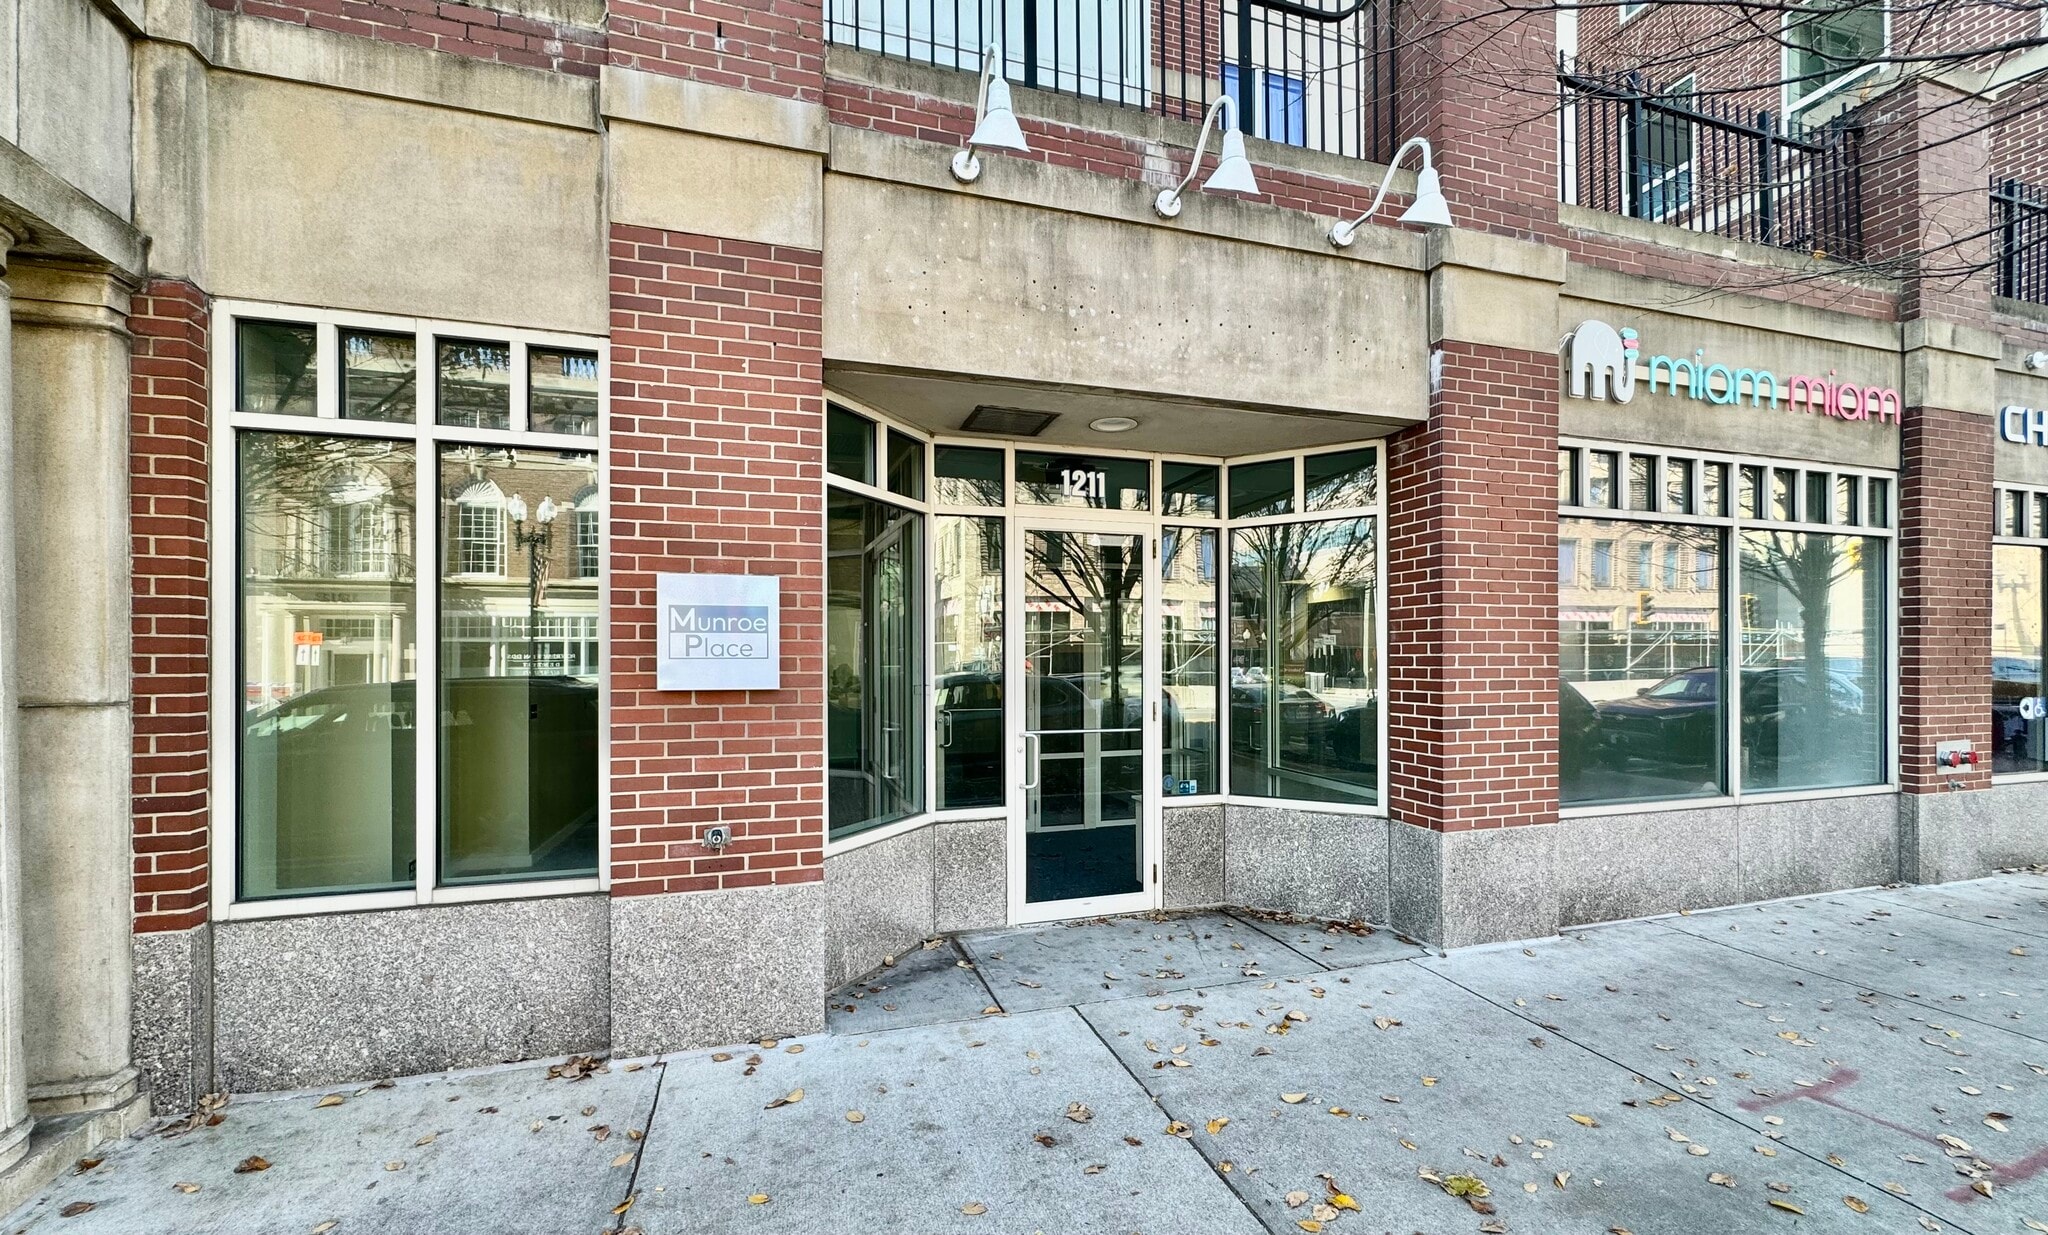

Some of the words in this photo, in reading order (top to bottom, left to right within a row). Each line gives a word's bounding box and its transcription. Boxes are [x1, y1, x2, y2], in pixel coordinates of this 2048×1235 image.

[1649, 348, 1777, 409] miam
[1789, 368, 1900, 425] miam
[1061, 469, 1106, 498] 1211
[670, 607, 767, 632] Munroe
[685, 634, 753, 657] Place
